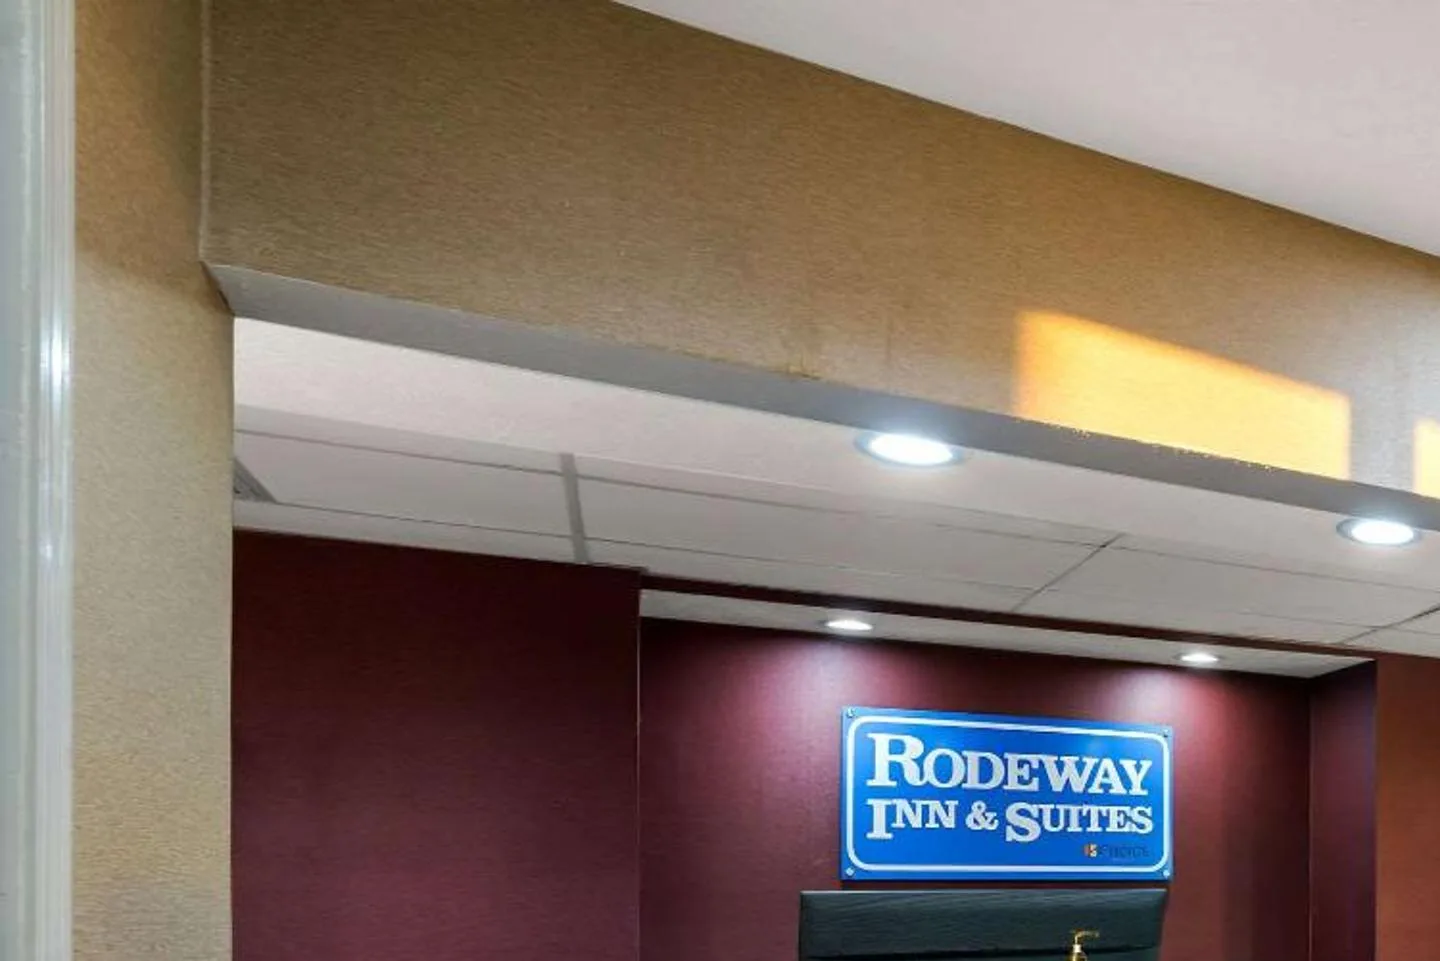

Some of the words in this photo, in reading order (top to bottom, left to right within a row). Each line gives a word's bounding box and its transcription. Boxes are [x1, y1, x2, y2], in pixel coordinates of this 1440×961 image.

[866, 732, 1152, 795] RODEWAY
[866, 798, 959, 839] INN
[965, 800, 999, 830] &
[1004, 802, 1153, 842] SUITES
